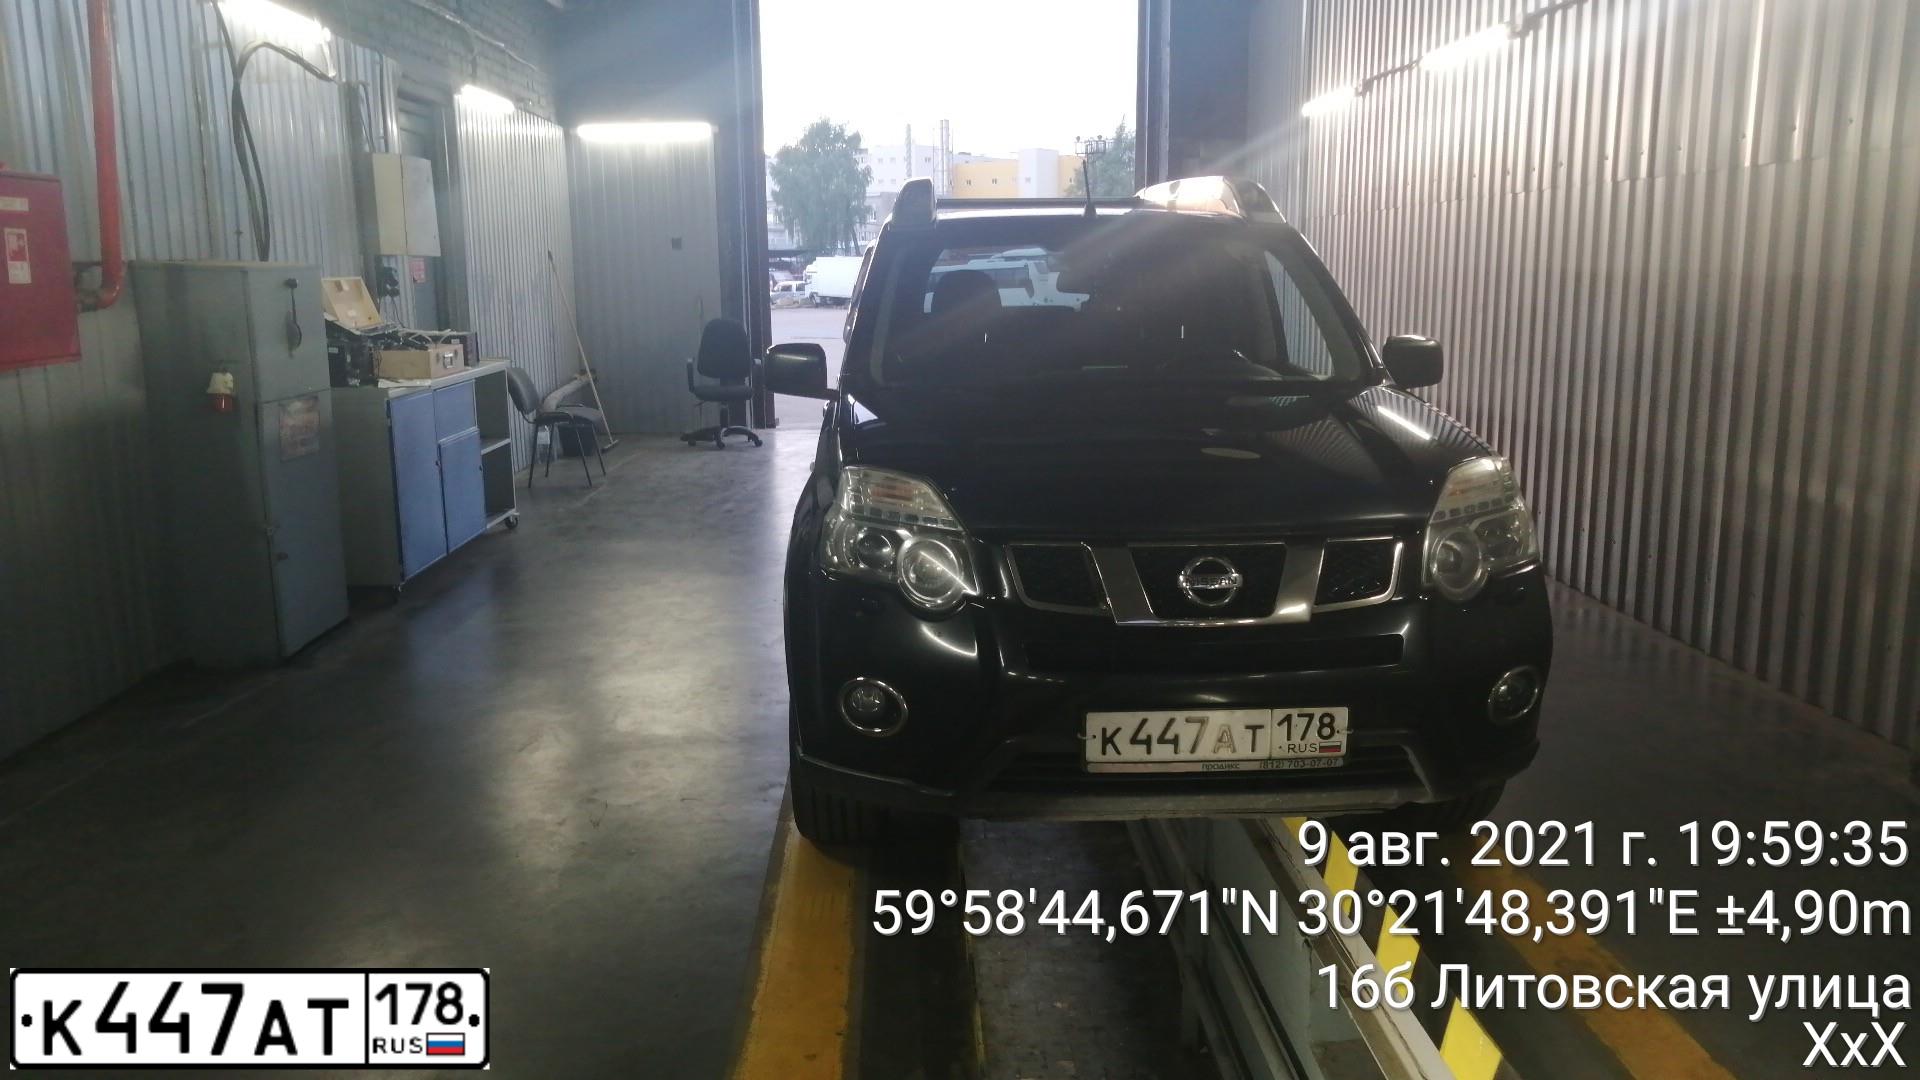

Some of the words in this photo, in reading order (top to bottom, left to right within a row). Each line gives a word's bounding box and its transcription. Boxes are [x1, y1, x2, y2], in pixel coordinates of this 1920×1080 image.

[1276, 712, 1337, 742] 178
[1287, 743, 1318, 754] RUS
[1259, 760, 1285, 770] (812)
[1288, 758, 1339, 769] 703-07-07
